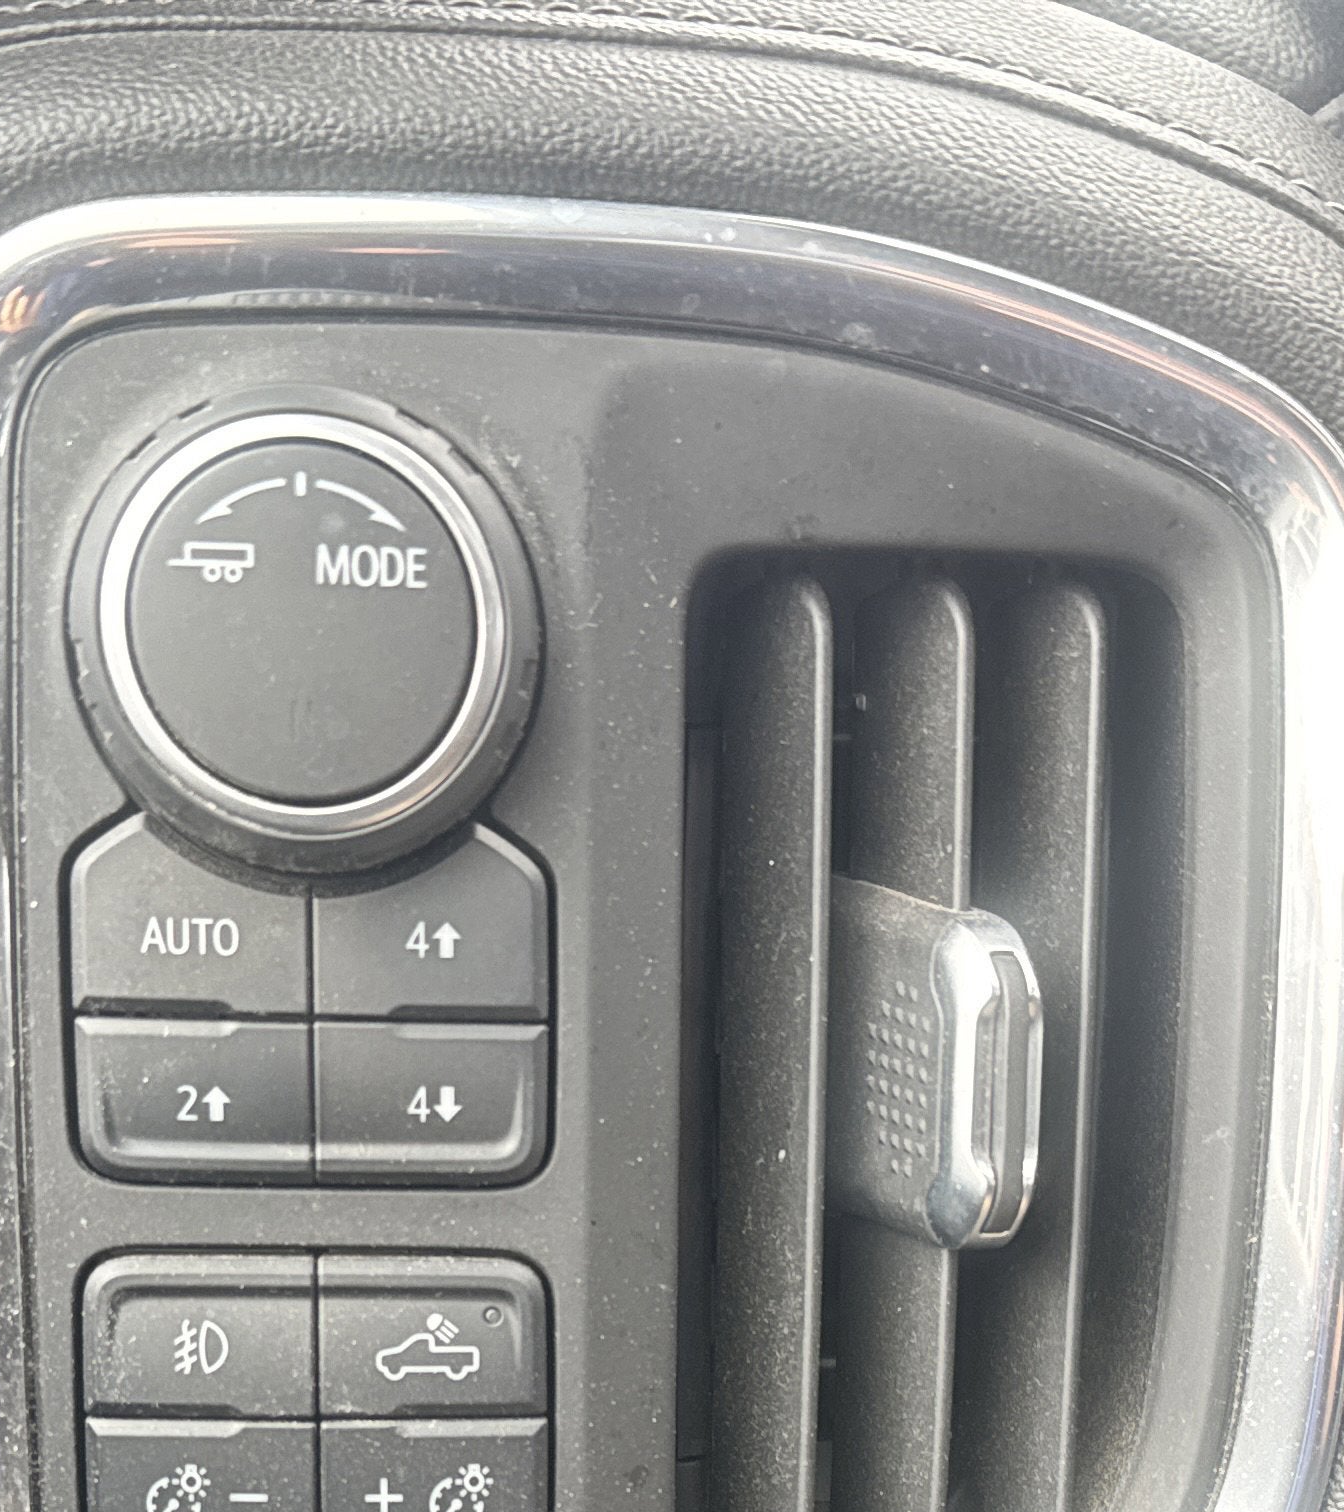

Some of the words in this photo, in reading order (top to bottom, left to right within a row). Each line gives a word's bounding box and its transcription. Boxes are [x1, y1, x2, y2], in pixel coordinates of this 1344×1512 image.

[315, 543, 428, 589] MODE
[139, 917, 240, 956] AUTO
[405, 921, 430, 959] 4
[176, 1085, 199, 1122] 2
[406, 1086, 431, 1123] 4
